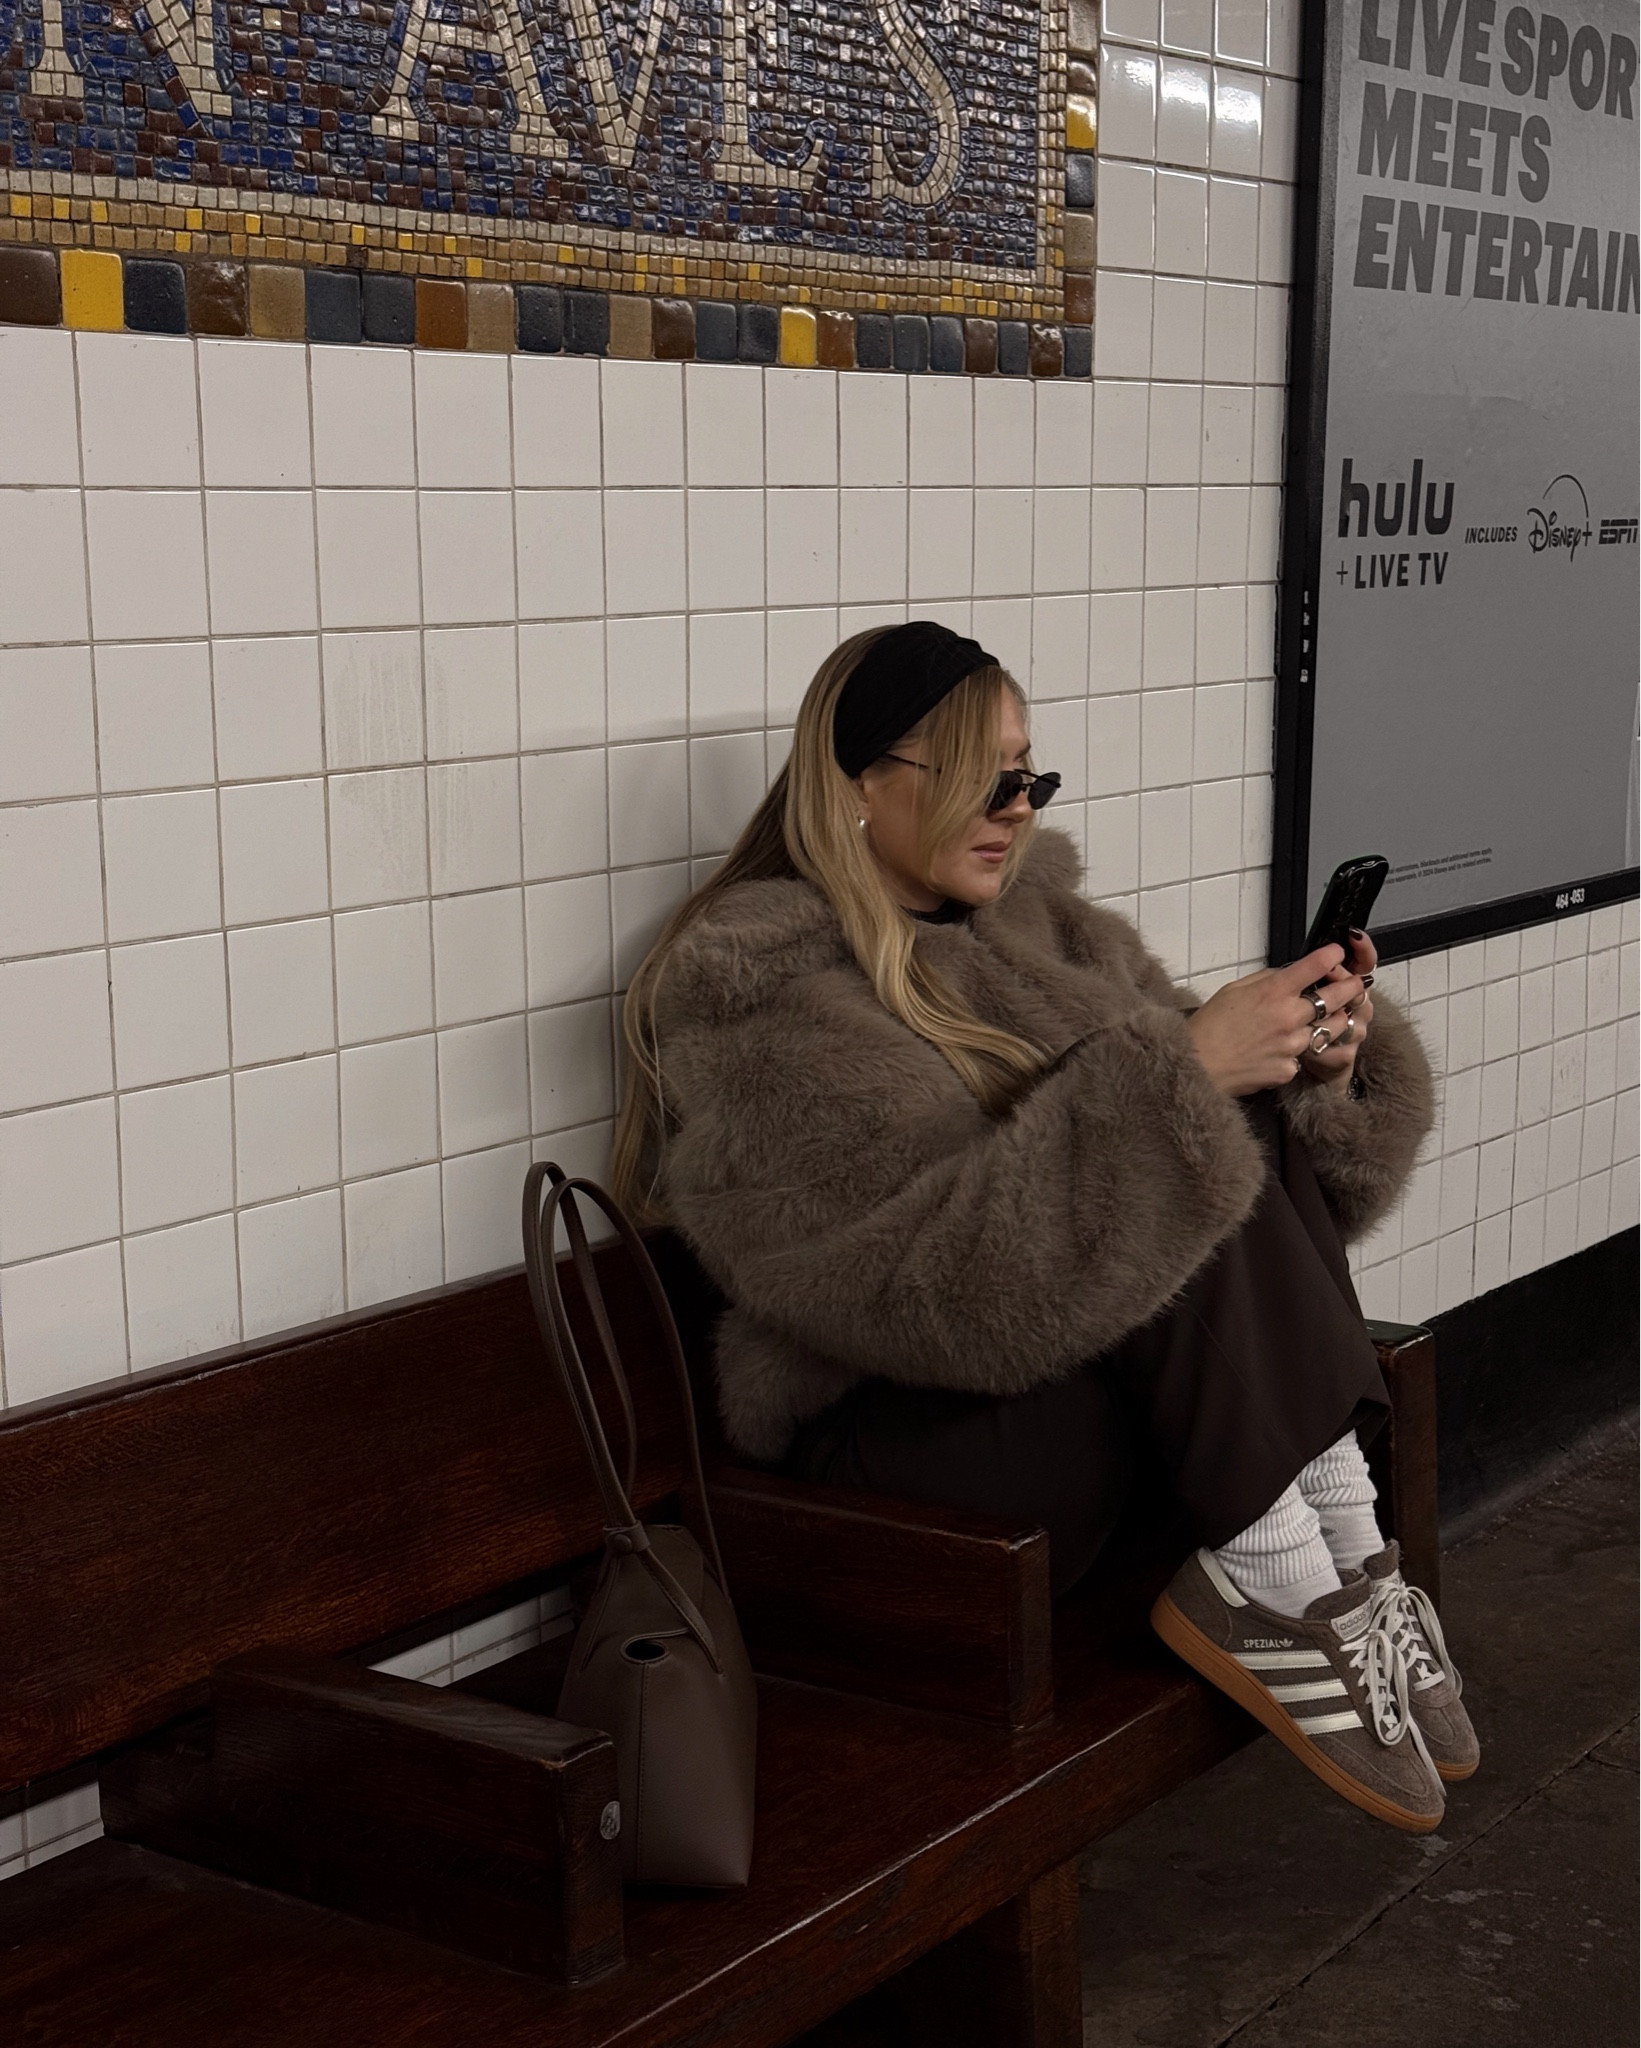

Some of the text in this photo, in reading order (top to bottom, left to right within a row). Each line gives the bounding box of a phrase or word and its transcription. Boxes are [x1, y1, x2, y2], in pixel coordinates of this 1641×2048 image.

[1358, 0, 1497, 88] LIVE
[1357, 81, 1552, 204] MEETS
[1353, 194, 1640, 314] ENTERTAIN
[1338, 458, 1455, 538] hulu
[1465, 526, 1518, 543] INCLUDES
[1599, 518, 1638, 544] ESPN
[1418, 551, 1449, 586] TV
[1243, 1638, 1281, 1649] SPEZIAL
